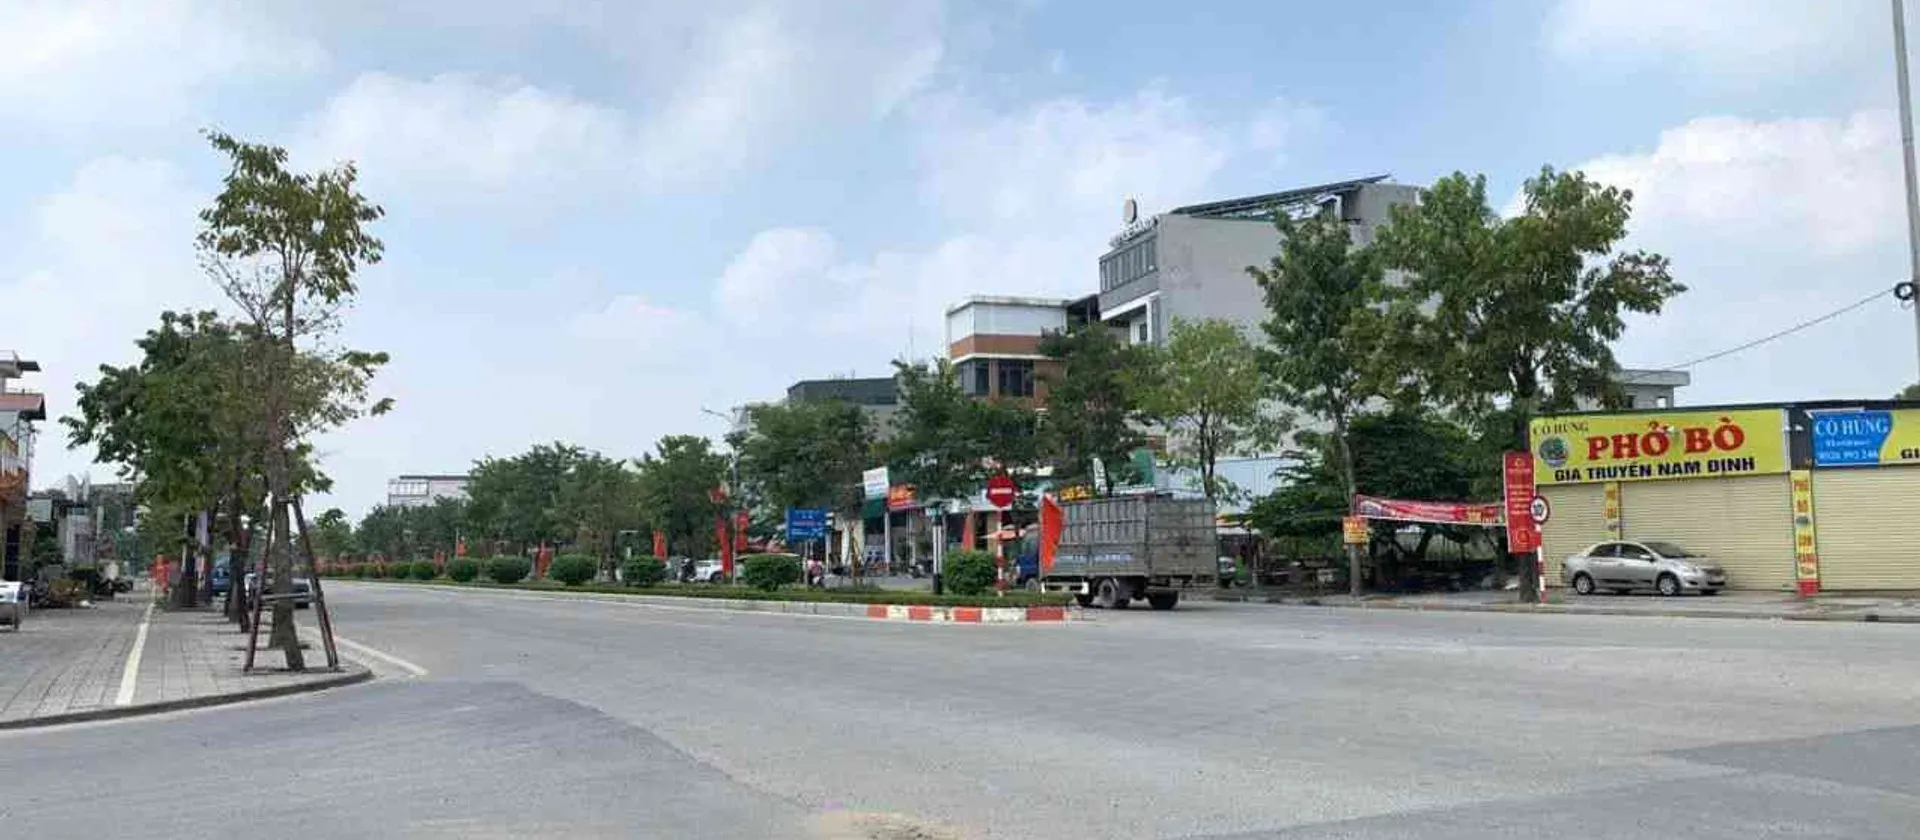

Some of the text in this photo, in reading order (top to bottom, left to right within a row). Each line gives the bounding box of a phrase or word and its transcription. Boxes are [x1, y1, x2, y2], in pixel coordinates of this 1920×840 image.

[1586, 416, 1746, 460] PHỞ BÒ
[1555, 469, 1582, 482] GIA
[1658, 460, 1701, 476] NAM
